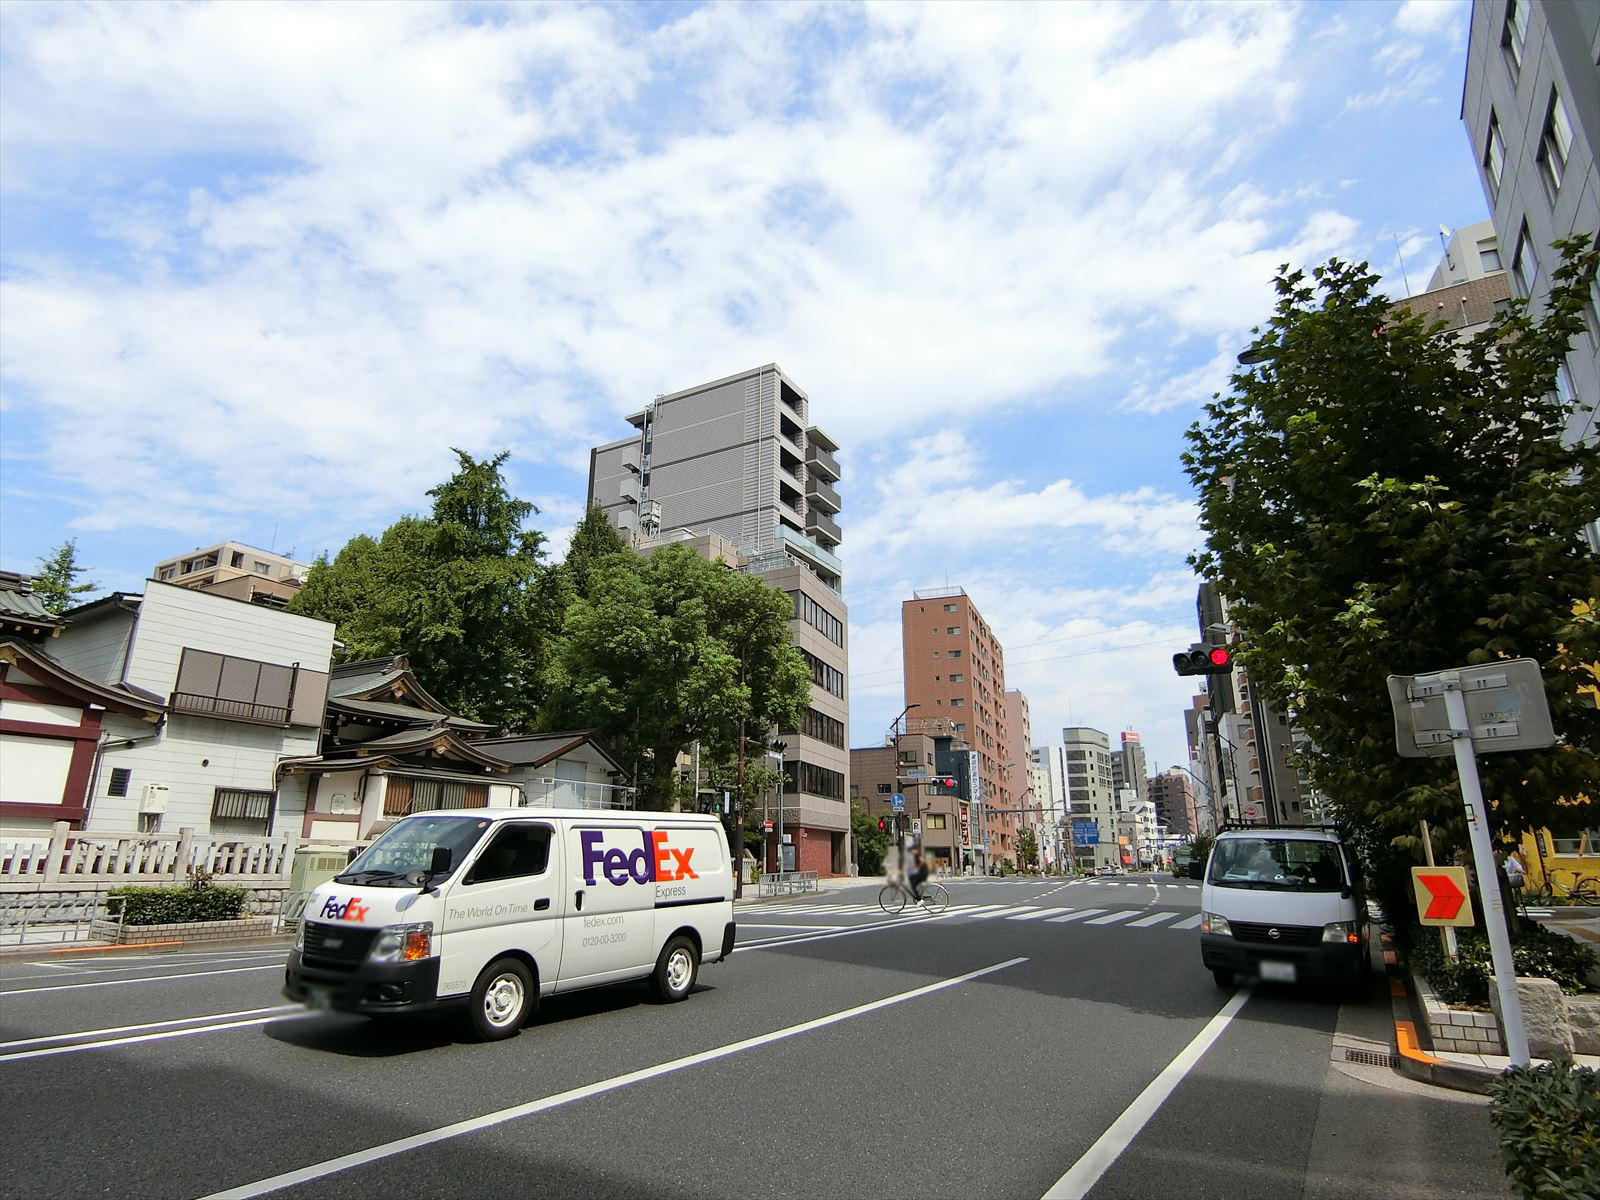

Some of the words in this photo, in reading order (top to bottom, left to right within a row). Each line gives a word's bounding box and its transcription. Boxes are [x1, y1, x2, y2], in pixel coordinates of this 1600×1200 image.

[580, 830, 700, 887] FedEx
[655, 885, 686, 899] Express
[320, 895, 370, 922] FedEx
[448, 908, 466, 920] The
[467, 905, 494, 918] World
[494, 904, 508, 916] On
[508, 903, 528, 914] Time
[583, 915, 624, 929] fedex.com
[582, 932, 627, 948] 0120-00-3200
